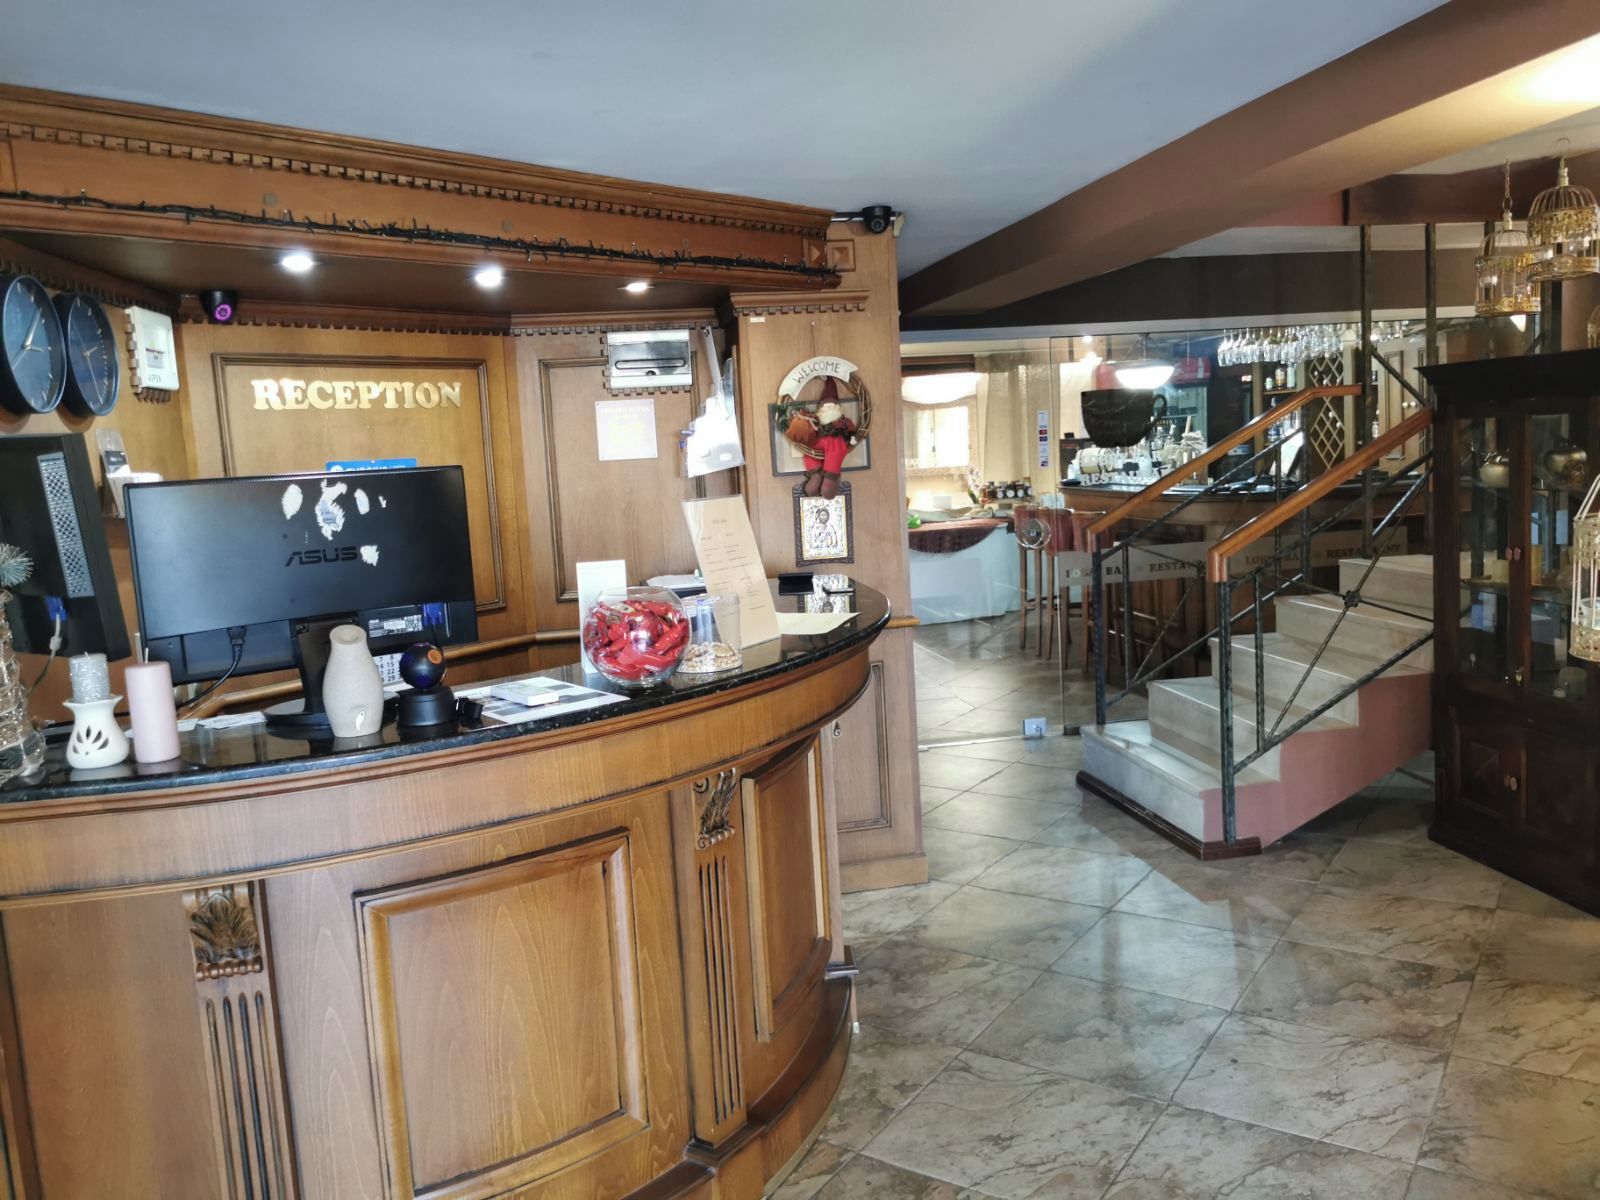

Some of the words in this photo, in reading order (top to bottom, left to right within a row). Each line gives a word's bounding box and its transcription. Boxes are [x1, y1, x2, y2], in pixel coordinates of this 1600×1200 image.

[792, 360, 841, 384] WELCOME
[251, 377, 462, 411] RECEPTION
[284, 545, 357, 567] ASUS
[1105, 565, 1123, 576] BA
